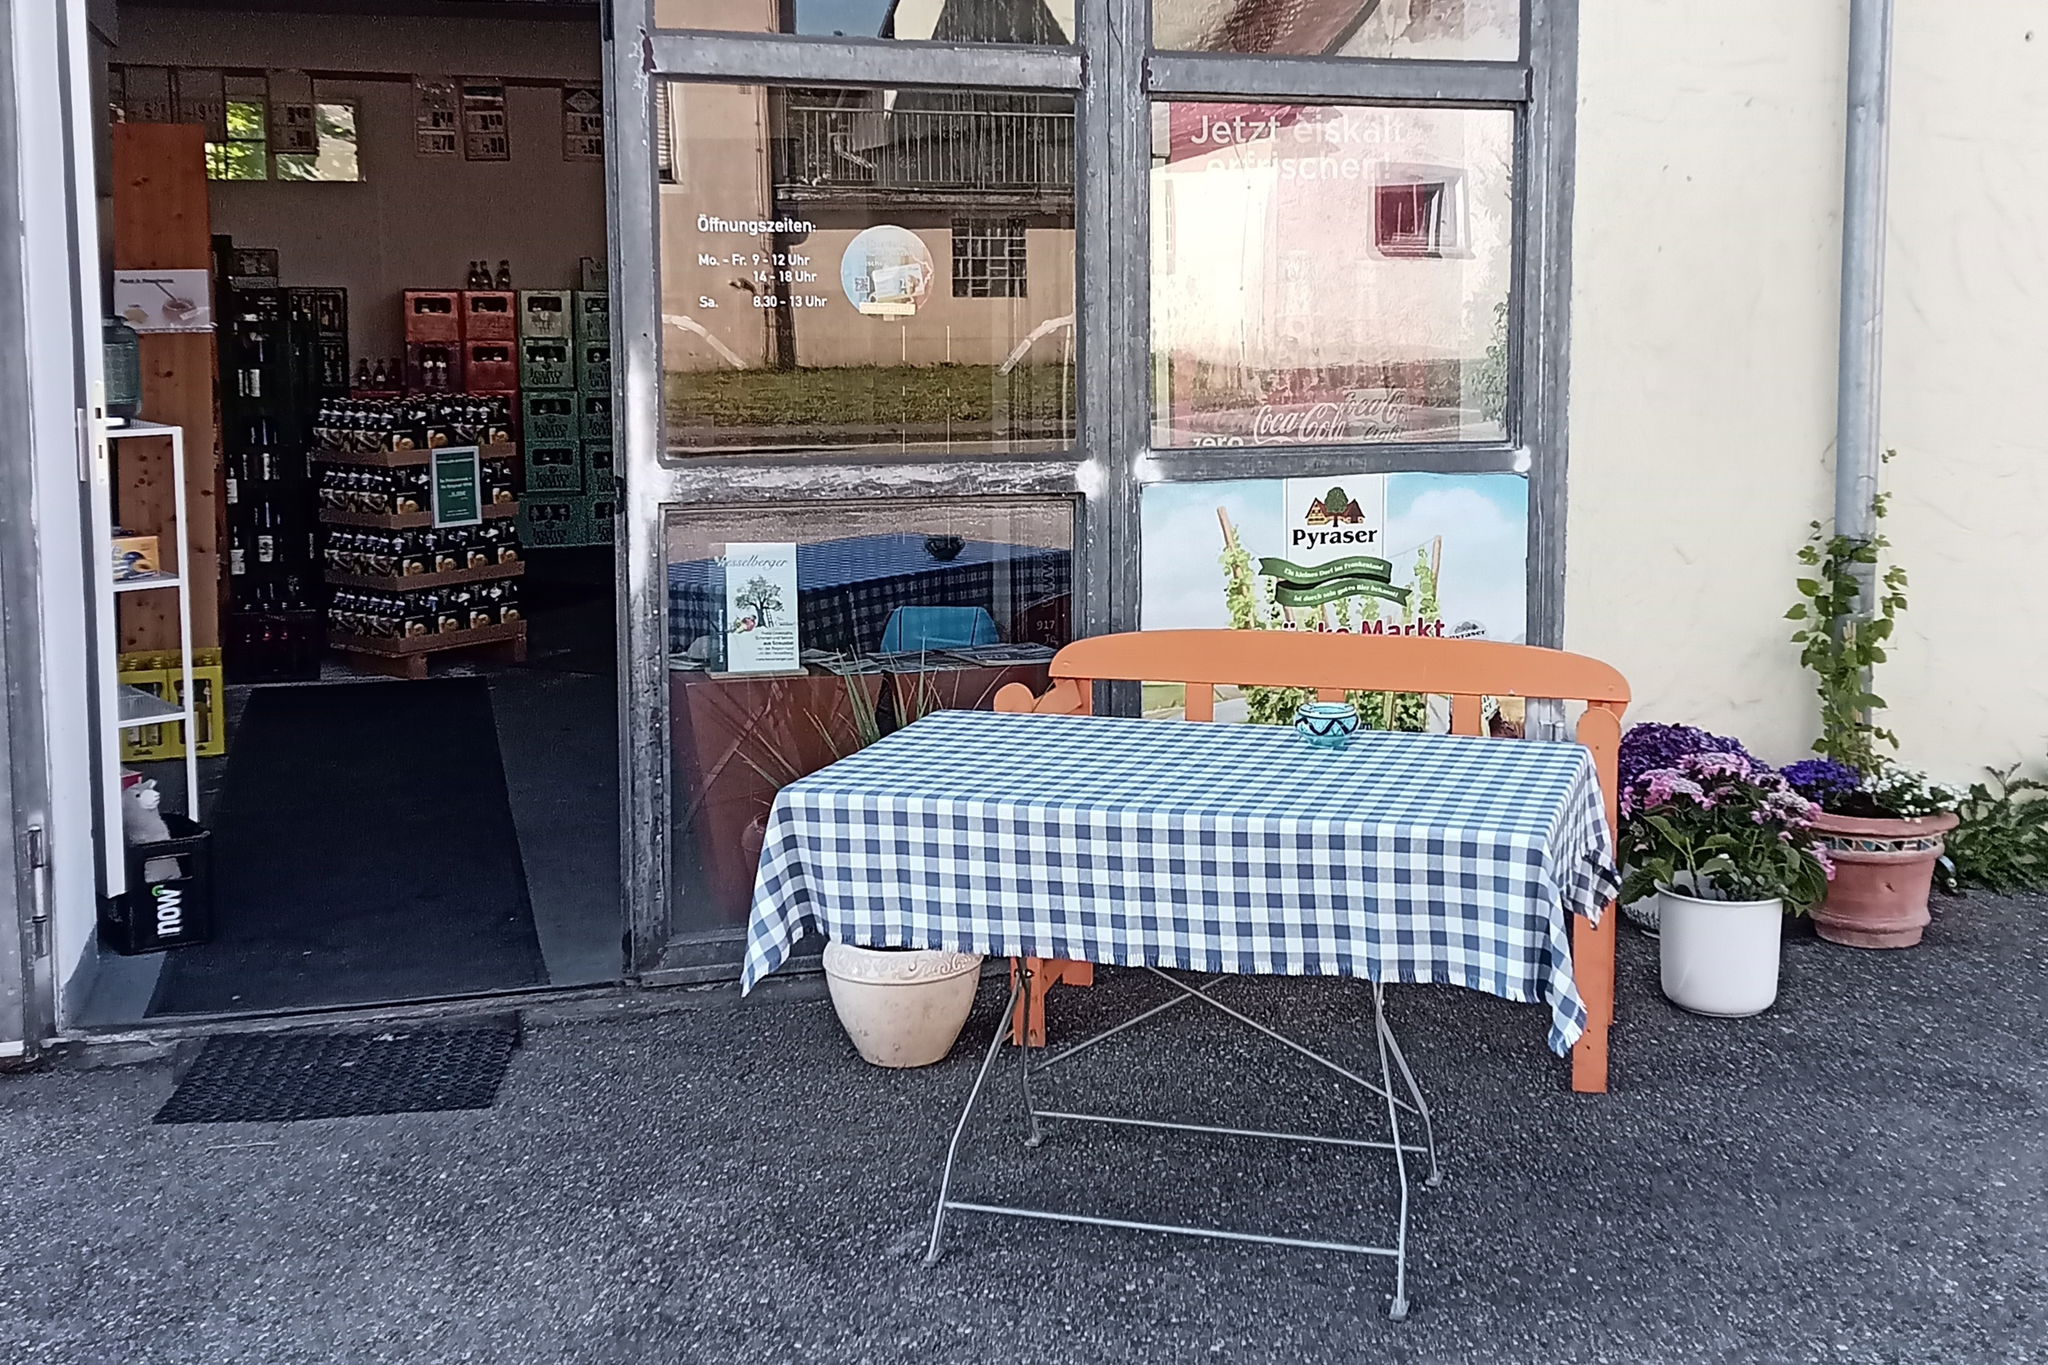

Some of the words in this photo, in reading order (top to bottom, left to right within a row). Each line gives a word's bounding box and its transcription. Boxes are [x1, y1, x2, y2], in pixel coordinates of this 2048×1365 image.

[1190, 114, 1281, 144] Jetzt
[697, 213, 817, 237] Öffnungszeiten:
[698, 253, 720, 266] Mo.
[731, 253, 748, 266] Fr.
[751, 253, 760, 266] 9
[771, 253, 786, 266] 12
[787, 253, 811, 266] Uhr
[752, 270, 768, 283] 14
[779, 270, 793, 283] 18
[794, 270, 818, 283] Uhr
[699, 295, 719, 308] Sa.
[752, 295, 778, 308] 8.30
[789, 295, 803, 308] 13
[805, 295, 828, 308] Uhr
[1292, 529, 1378, 550] Pyraser
[1283, 566, 1295, 578] Ein
[1295, 570, 1319, 579] kleines
[1319, 567, 1334, 577] Dorf
[1334, 565, 1343, 573] im
[1344, 560, 1384, 571] Frankenland
[1303, 593, 1322, 602] durch
[1337, 585, 1356, 596] gutes
[1356, 583, 1370, 592] Bier
[1370, 584, 1399, 599] bekannt!
[1036, 620, 1055, 631] 917
[1361, 617, 1446, 639] Markt
[152, 884, 182, 936] now
